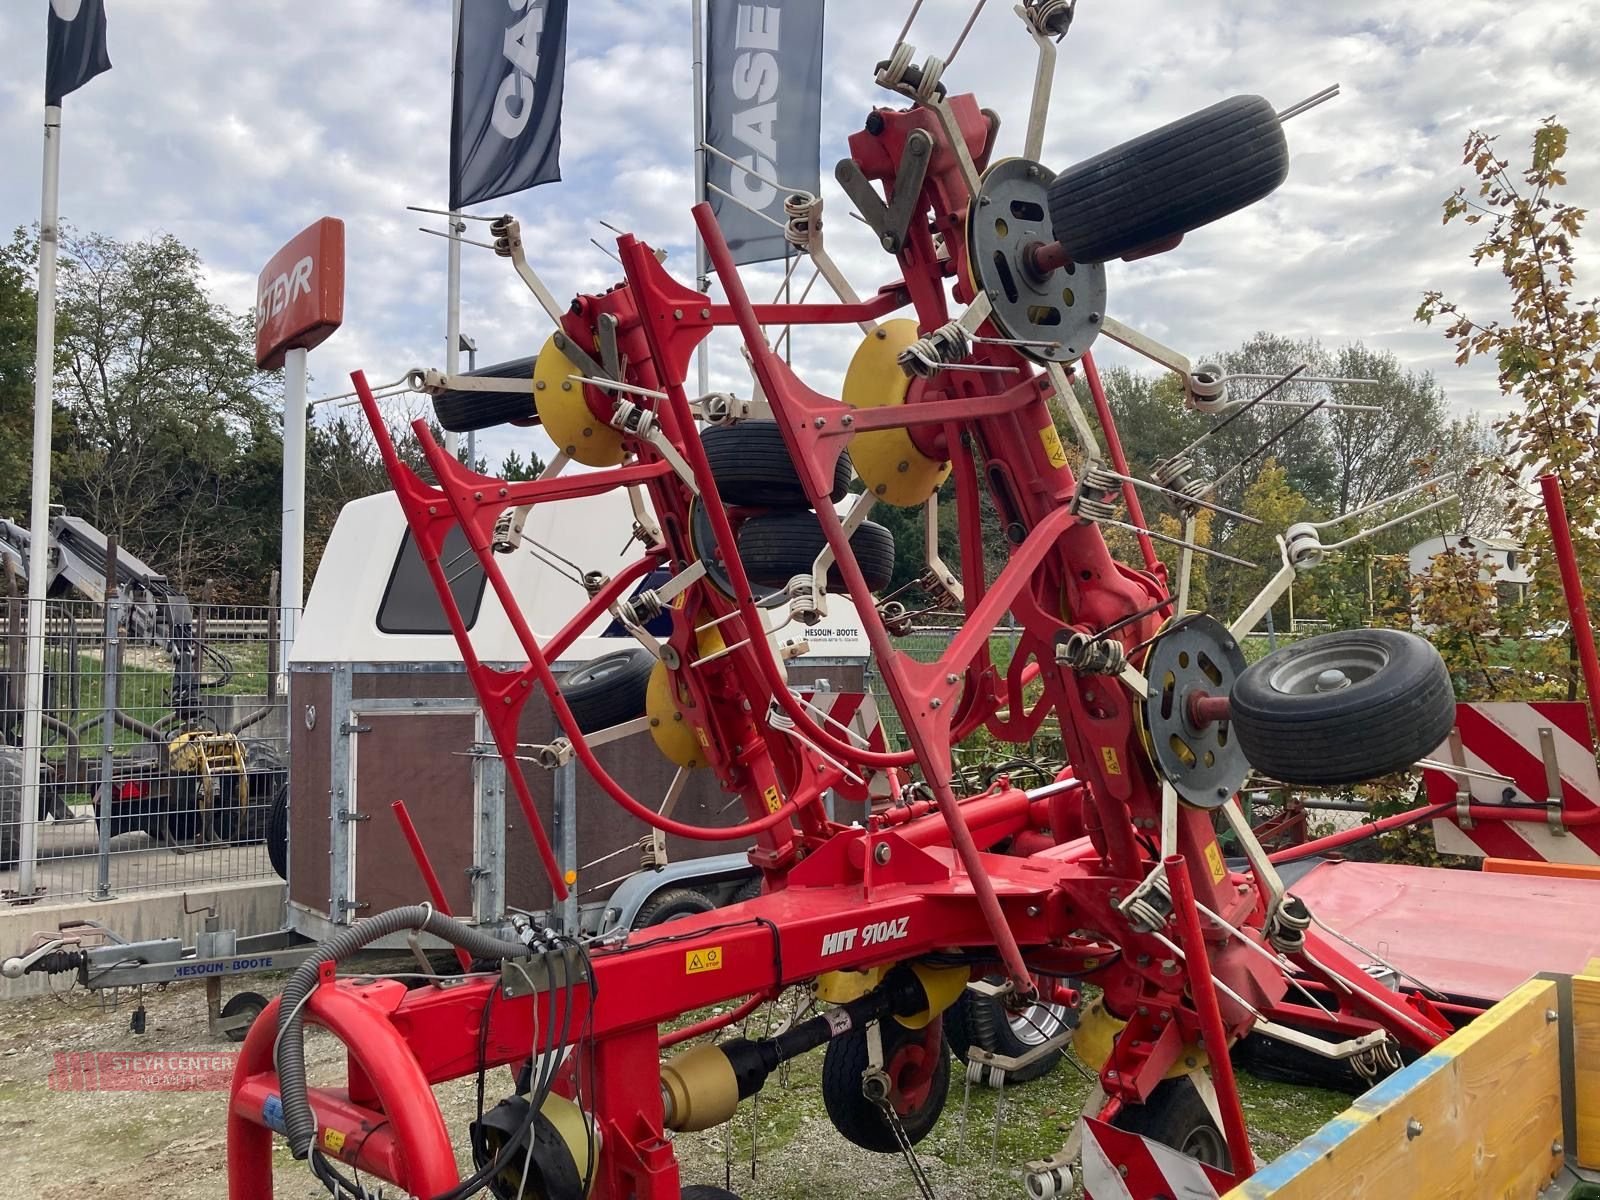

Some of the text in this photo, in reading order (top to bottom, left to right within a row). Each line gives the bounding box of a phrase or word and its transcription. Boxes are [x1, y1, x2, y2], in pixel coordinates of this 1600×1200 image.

[491, 0, 544, 139] CA
[730, 3, 781, 210] CASE
[257, 255, 314, 331] STEYR
[804, 629, 832, 637] HESOUN
[836, 629, 858, 637] BOOTE
[232, 957, 273, 971] BOOTE
[821, 916, 910, 957] HIT 910AZ
